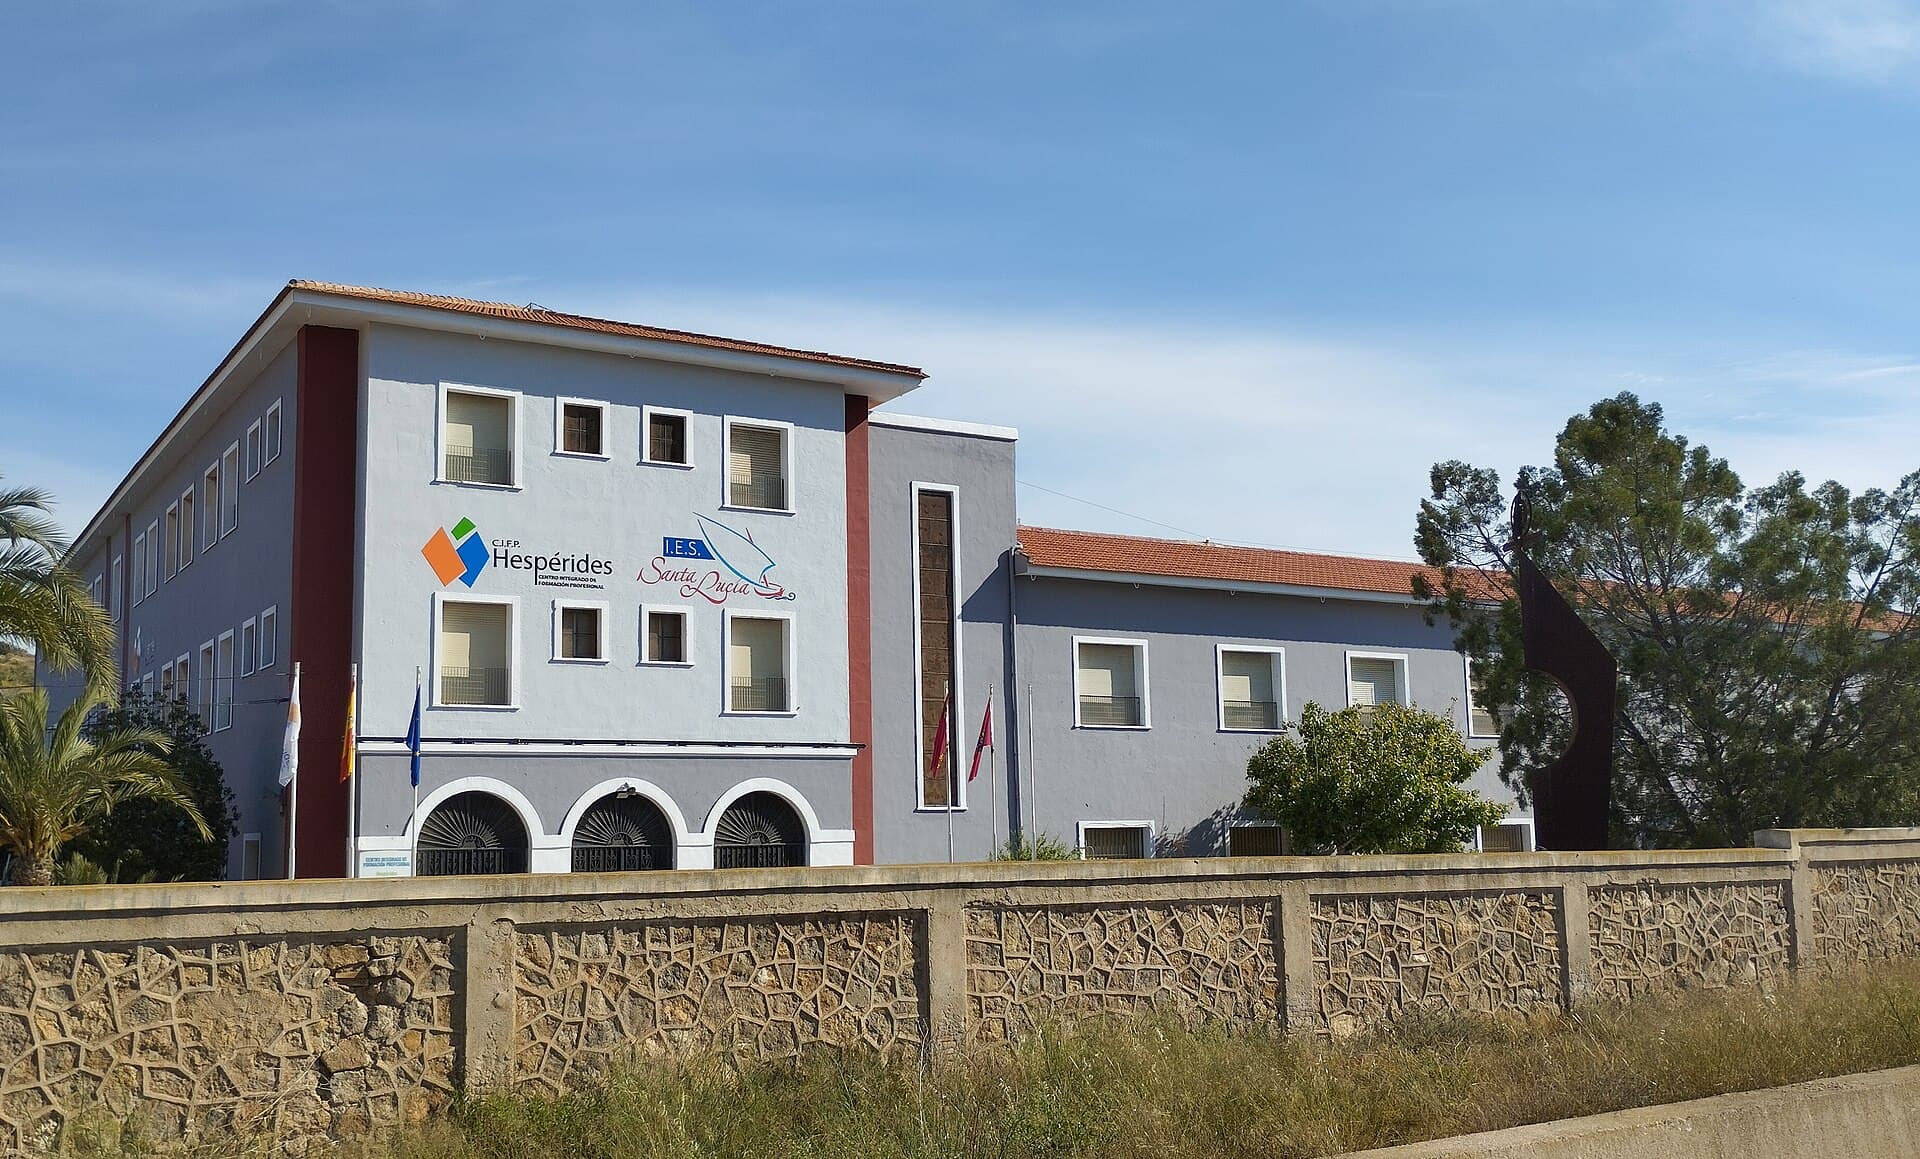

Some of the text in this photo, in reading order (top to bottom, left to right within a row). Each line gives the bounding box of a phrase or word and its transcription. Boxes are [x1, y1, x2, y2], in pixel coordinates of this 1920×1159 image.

[492, 539, 521, 548] C.I.F.P.
[665, 539, 701, 556] I.E.S.
[493, 548, 613, 585] Hespérides
[636, 556, 698, 584] Santa
